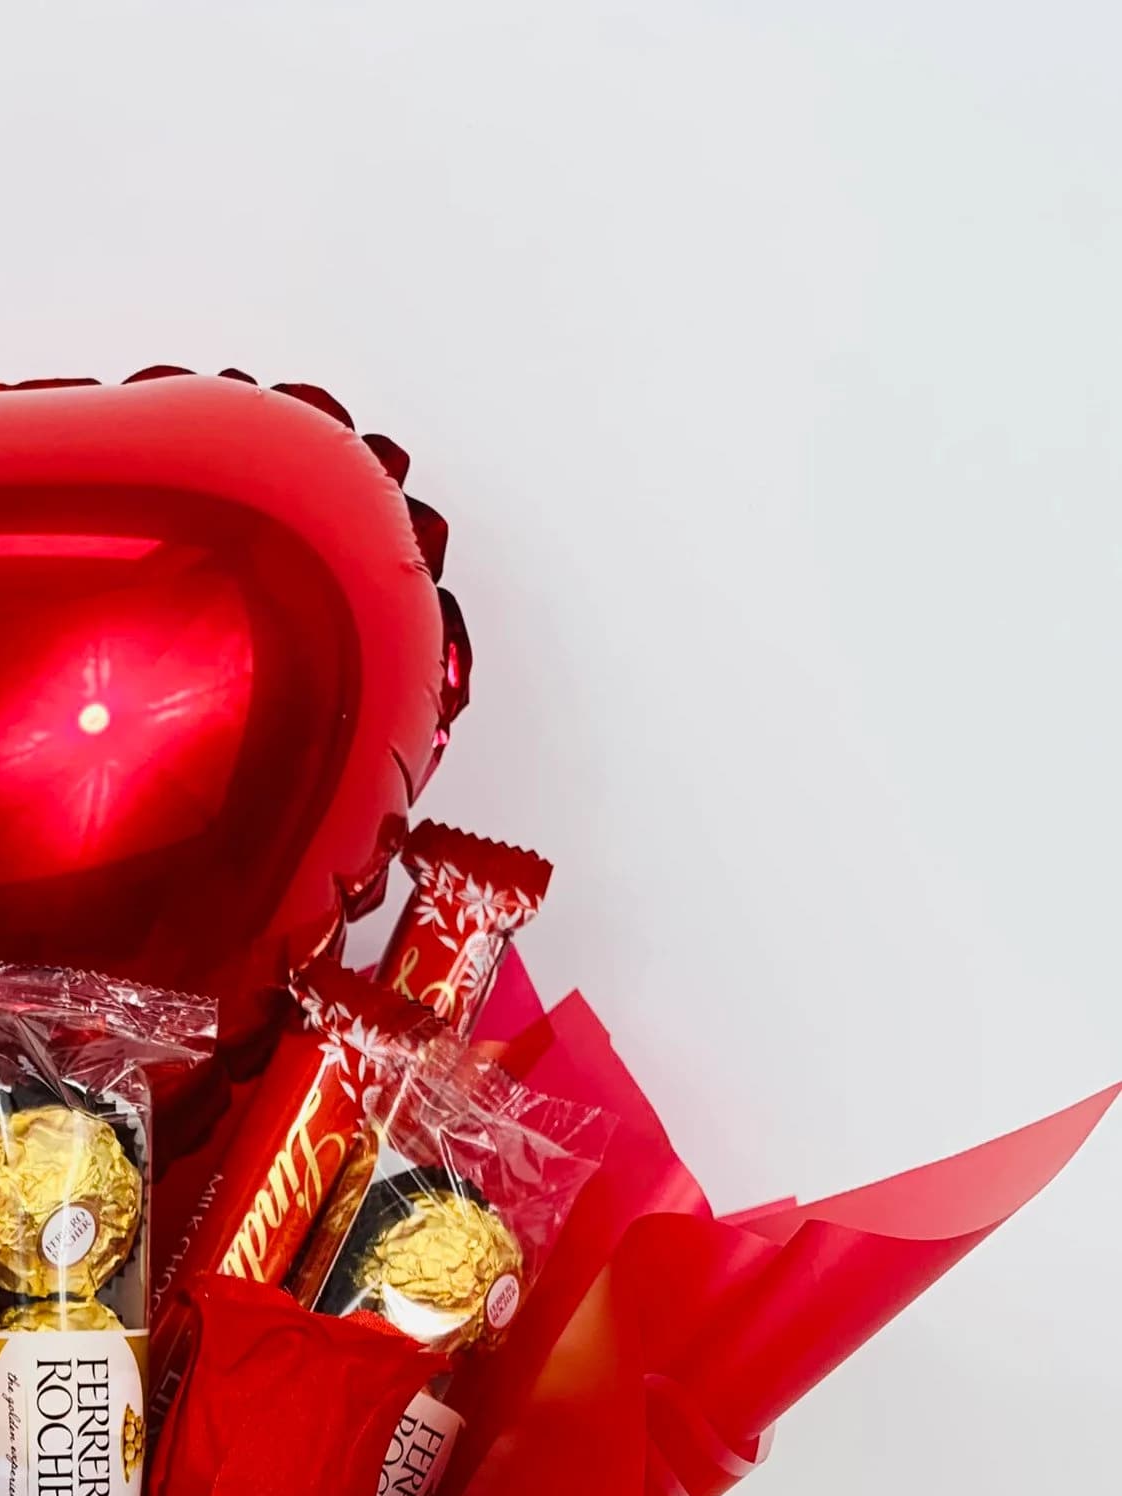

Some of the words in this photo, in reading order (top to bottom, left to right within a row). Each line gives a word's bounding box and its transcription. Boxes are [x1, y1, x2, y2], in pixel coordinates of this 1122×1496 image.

[150, 1236, 190, 1320] CHOC
[6, 1371, 20, 1393] the
[2, 1391, 22, 1441] golden
